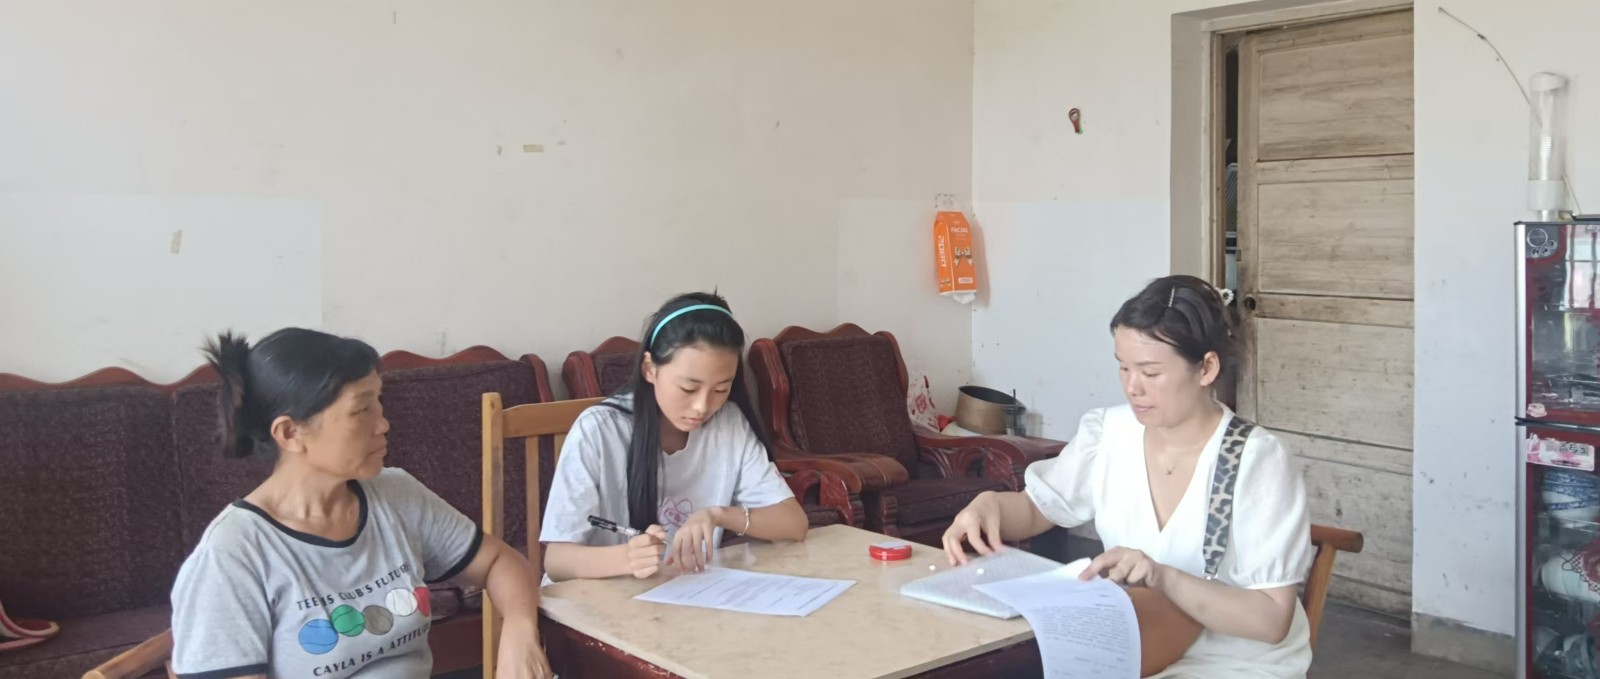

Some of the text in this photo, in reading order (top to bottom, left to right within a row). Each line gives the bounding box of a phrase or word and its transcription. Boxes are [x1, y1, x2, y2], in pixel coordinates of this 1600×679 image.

[338, 584, 374, 600] CLUB'S
[313, 657, 356, 677] CAYLA
[361, 651, 372, 663] IS
[377, 646, 385, 655] A
